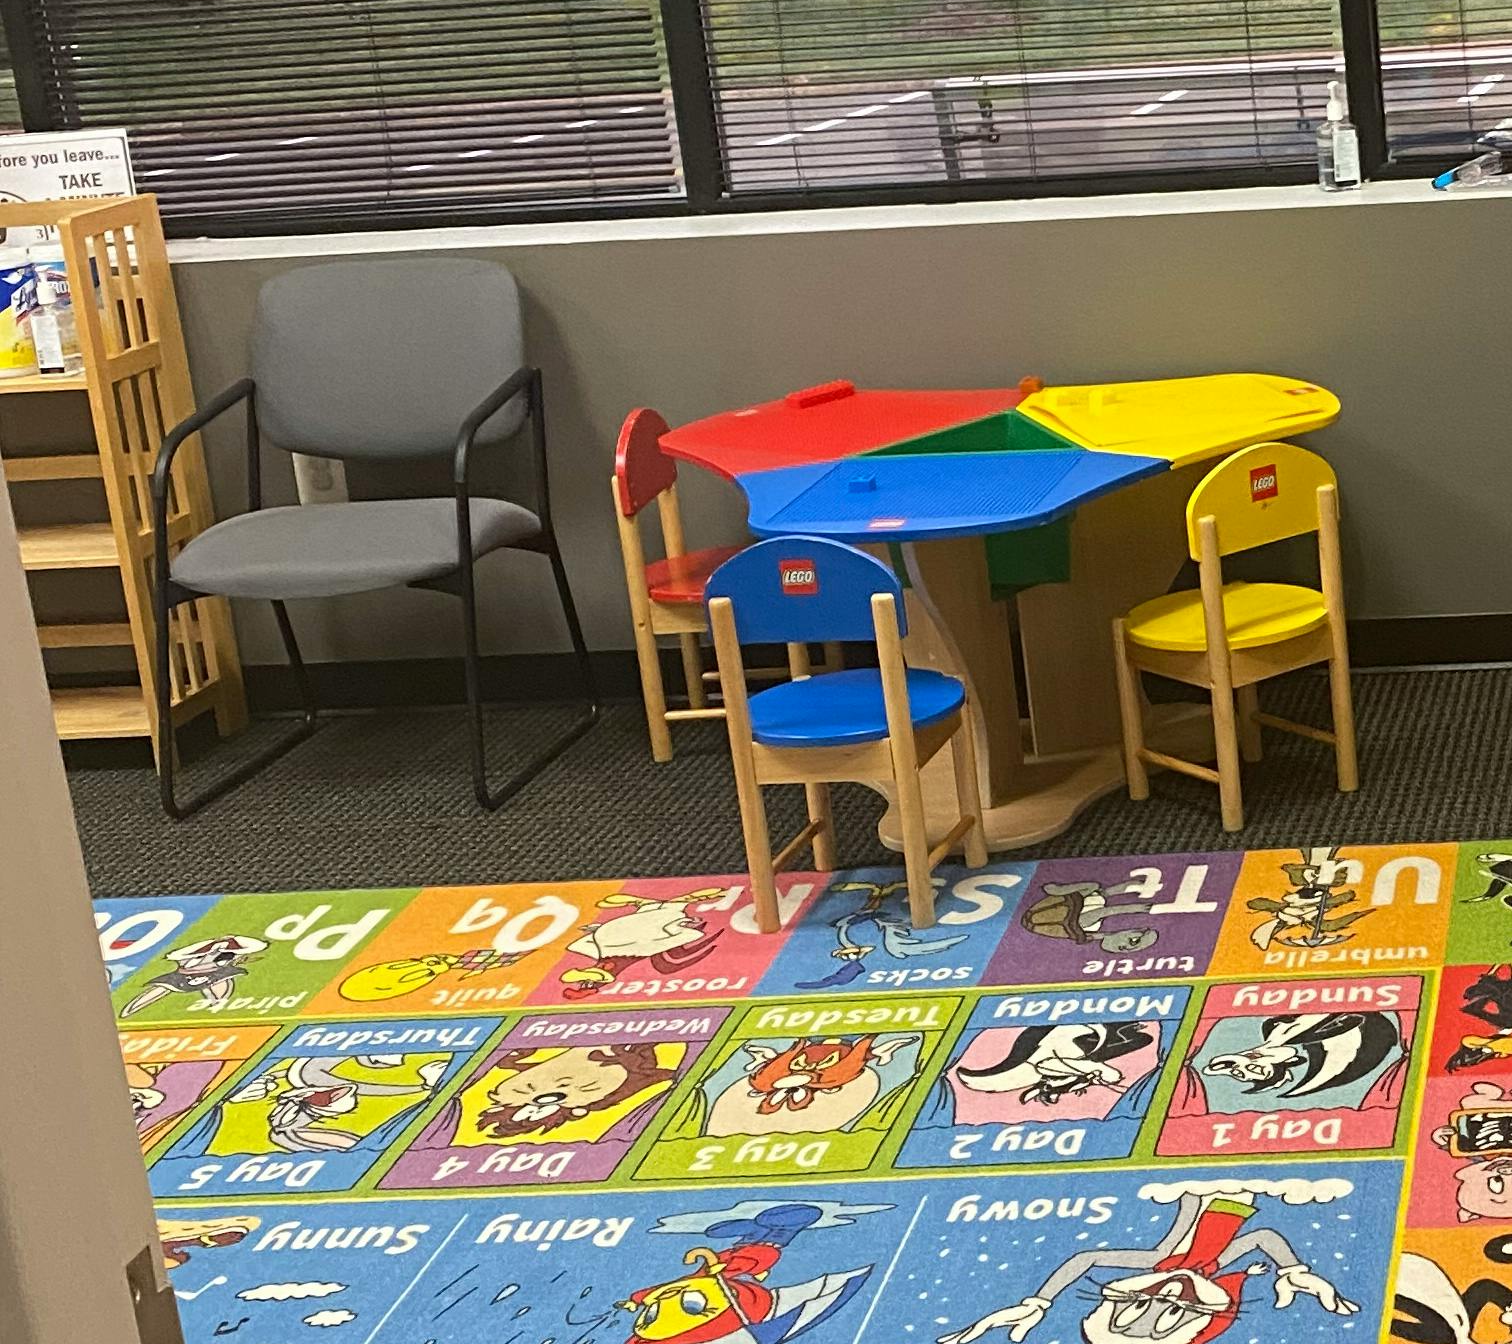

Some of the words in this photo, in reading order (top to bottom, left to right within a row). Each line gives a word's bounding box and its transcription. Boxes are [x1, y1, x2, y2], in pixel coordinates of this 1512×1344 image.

[31, 153, 58, 168] you
[63, 149, 119, 163] leave...
[59, 172, 103, 190] TAKE
[1253, 475, 1276, 491] LEGO
[783, 569, 815, 584] LEGO
[1125, 864, 1218, 914] Tt
[1319, 854, 1442, 905] Uu
[94, 909, 184, 961] O
[264, 905, 390, 960] Pp
[450, 896, 578, 953] Qq
[1083, 956, 1194, 976] turtle
[1264, 946, 1428, 968] umbrella
[599, 977, 748, 996] rooster
[867, 966, 973, 986] socks
[187, 990, 304, 1015] pirate
[432, 984, 520, 1006] quilt
[994, 993, 1174, 1020] Monday
[1232, 986, 1400, 1009] Sunday
[522, 1017, 711, 1040] Wednesday
[756, 1004, 940, 1031] Tuesday
[119, 1035, 237, 1058] Frida
[296, 1025, 480, 1050] Thursday
[992, 1128, 1086, 1154] Day
[1213, 1123, 1236, 1146] 1
[1251, 1118, 1343, 1145] Day
[737, 1142, 831, 1169] Day
[949, 1135, 973, 1158] 2
[431, 1157, 461, 1181] 4
[479, 1150, 575, 1176] Day
[689, 1148, 715, 1171] 3
[179, 1164, 214, 1189] 5
[226, 1160, 326, 1186] Day
[948, 1195, 1118, 1224] Snowy
[255, 1222, 431, 1254] Sunny
[475, 1214, 634, 1248] Rainy
